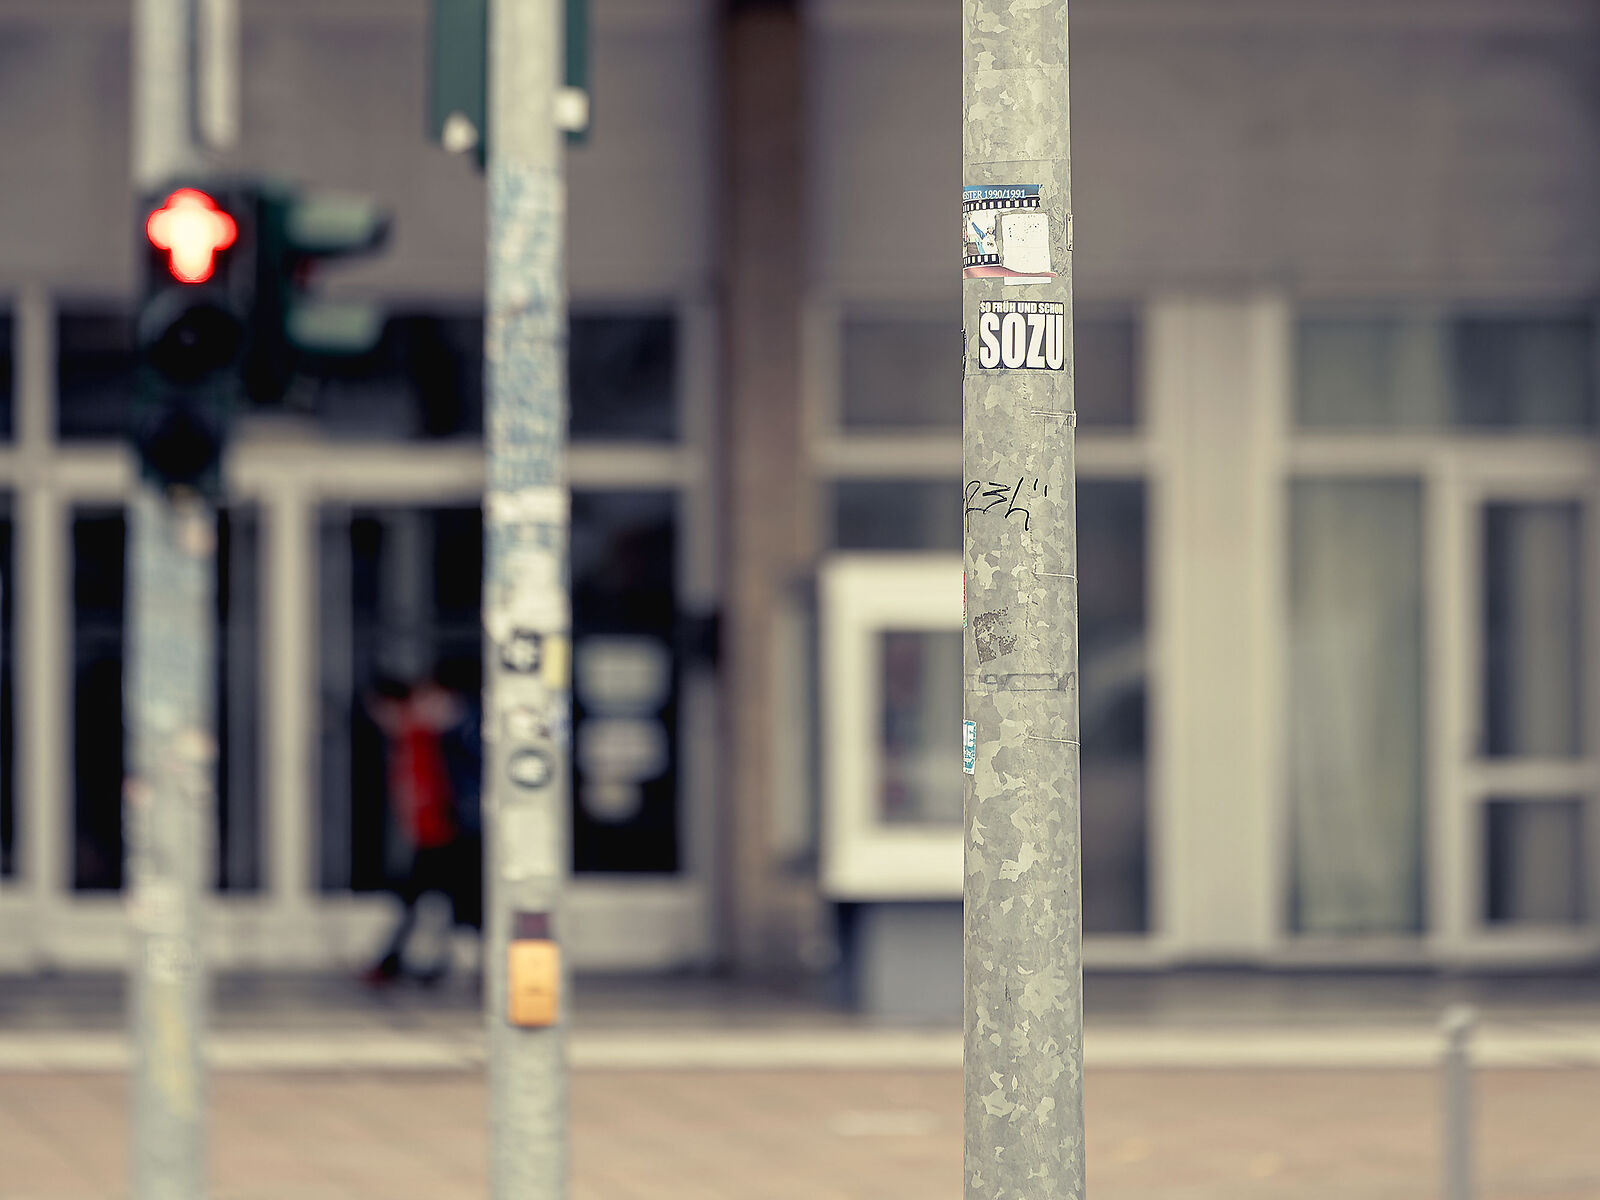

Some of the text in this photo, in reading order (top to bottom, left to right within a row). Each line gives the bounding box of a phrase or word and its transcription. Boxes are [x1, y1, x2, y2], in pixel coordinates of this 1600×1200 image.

[984, 189, 1026, 200] 1990/1991
[980, 302, 992, 313] SO
[992, 300, 1016, 313] FRÜH
[1017, 302, 1038, 314] UND
[979, 312, 1064, 371] SOZU
